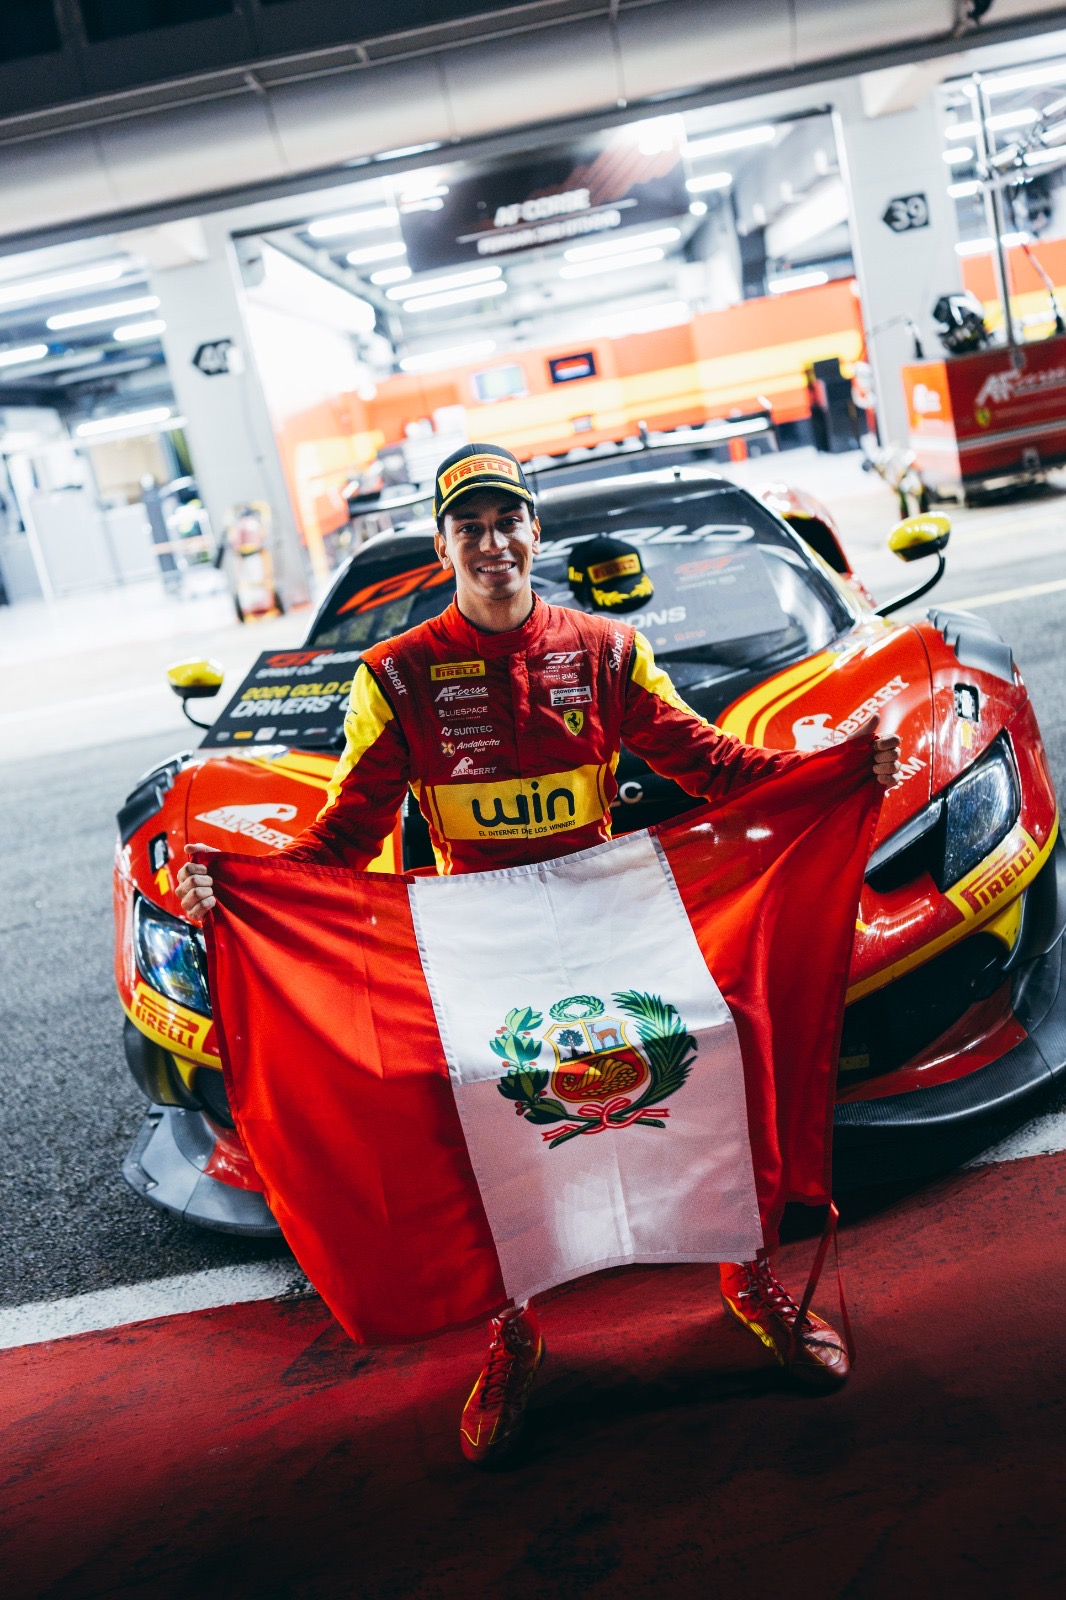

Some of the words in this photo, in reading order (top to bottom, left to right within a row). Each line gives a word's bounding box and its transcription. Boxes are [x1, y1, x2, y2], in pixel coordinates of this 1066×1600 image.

[890, 196, 927, 230] 39
[443, 457, 513, 490] PIRELLI
[542, 649, 588, 664] GT
[608, 629, 625, 672] Sabelt
[381, 656, 409, 696] Sabelt
[435, 663, 480, 678] PIRELLI
[561, 672, 579, 680] aws
[290, 681, 339, 698] GOLD
[438, 705, 488, 718] BLUESPACE
[453, 725, 493, 736] SUMTEC
[471, 781, 576, 828] win
[488, 828, 519, 836] INTERNET
[549, 820, 576, 831] WINNERS
[959, 838, 1035, 915] PIRELLI
[135, 993, 200, 1050] PIRELLI
